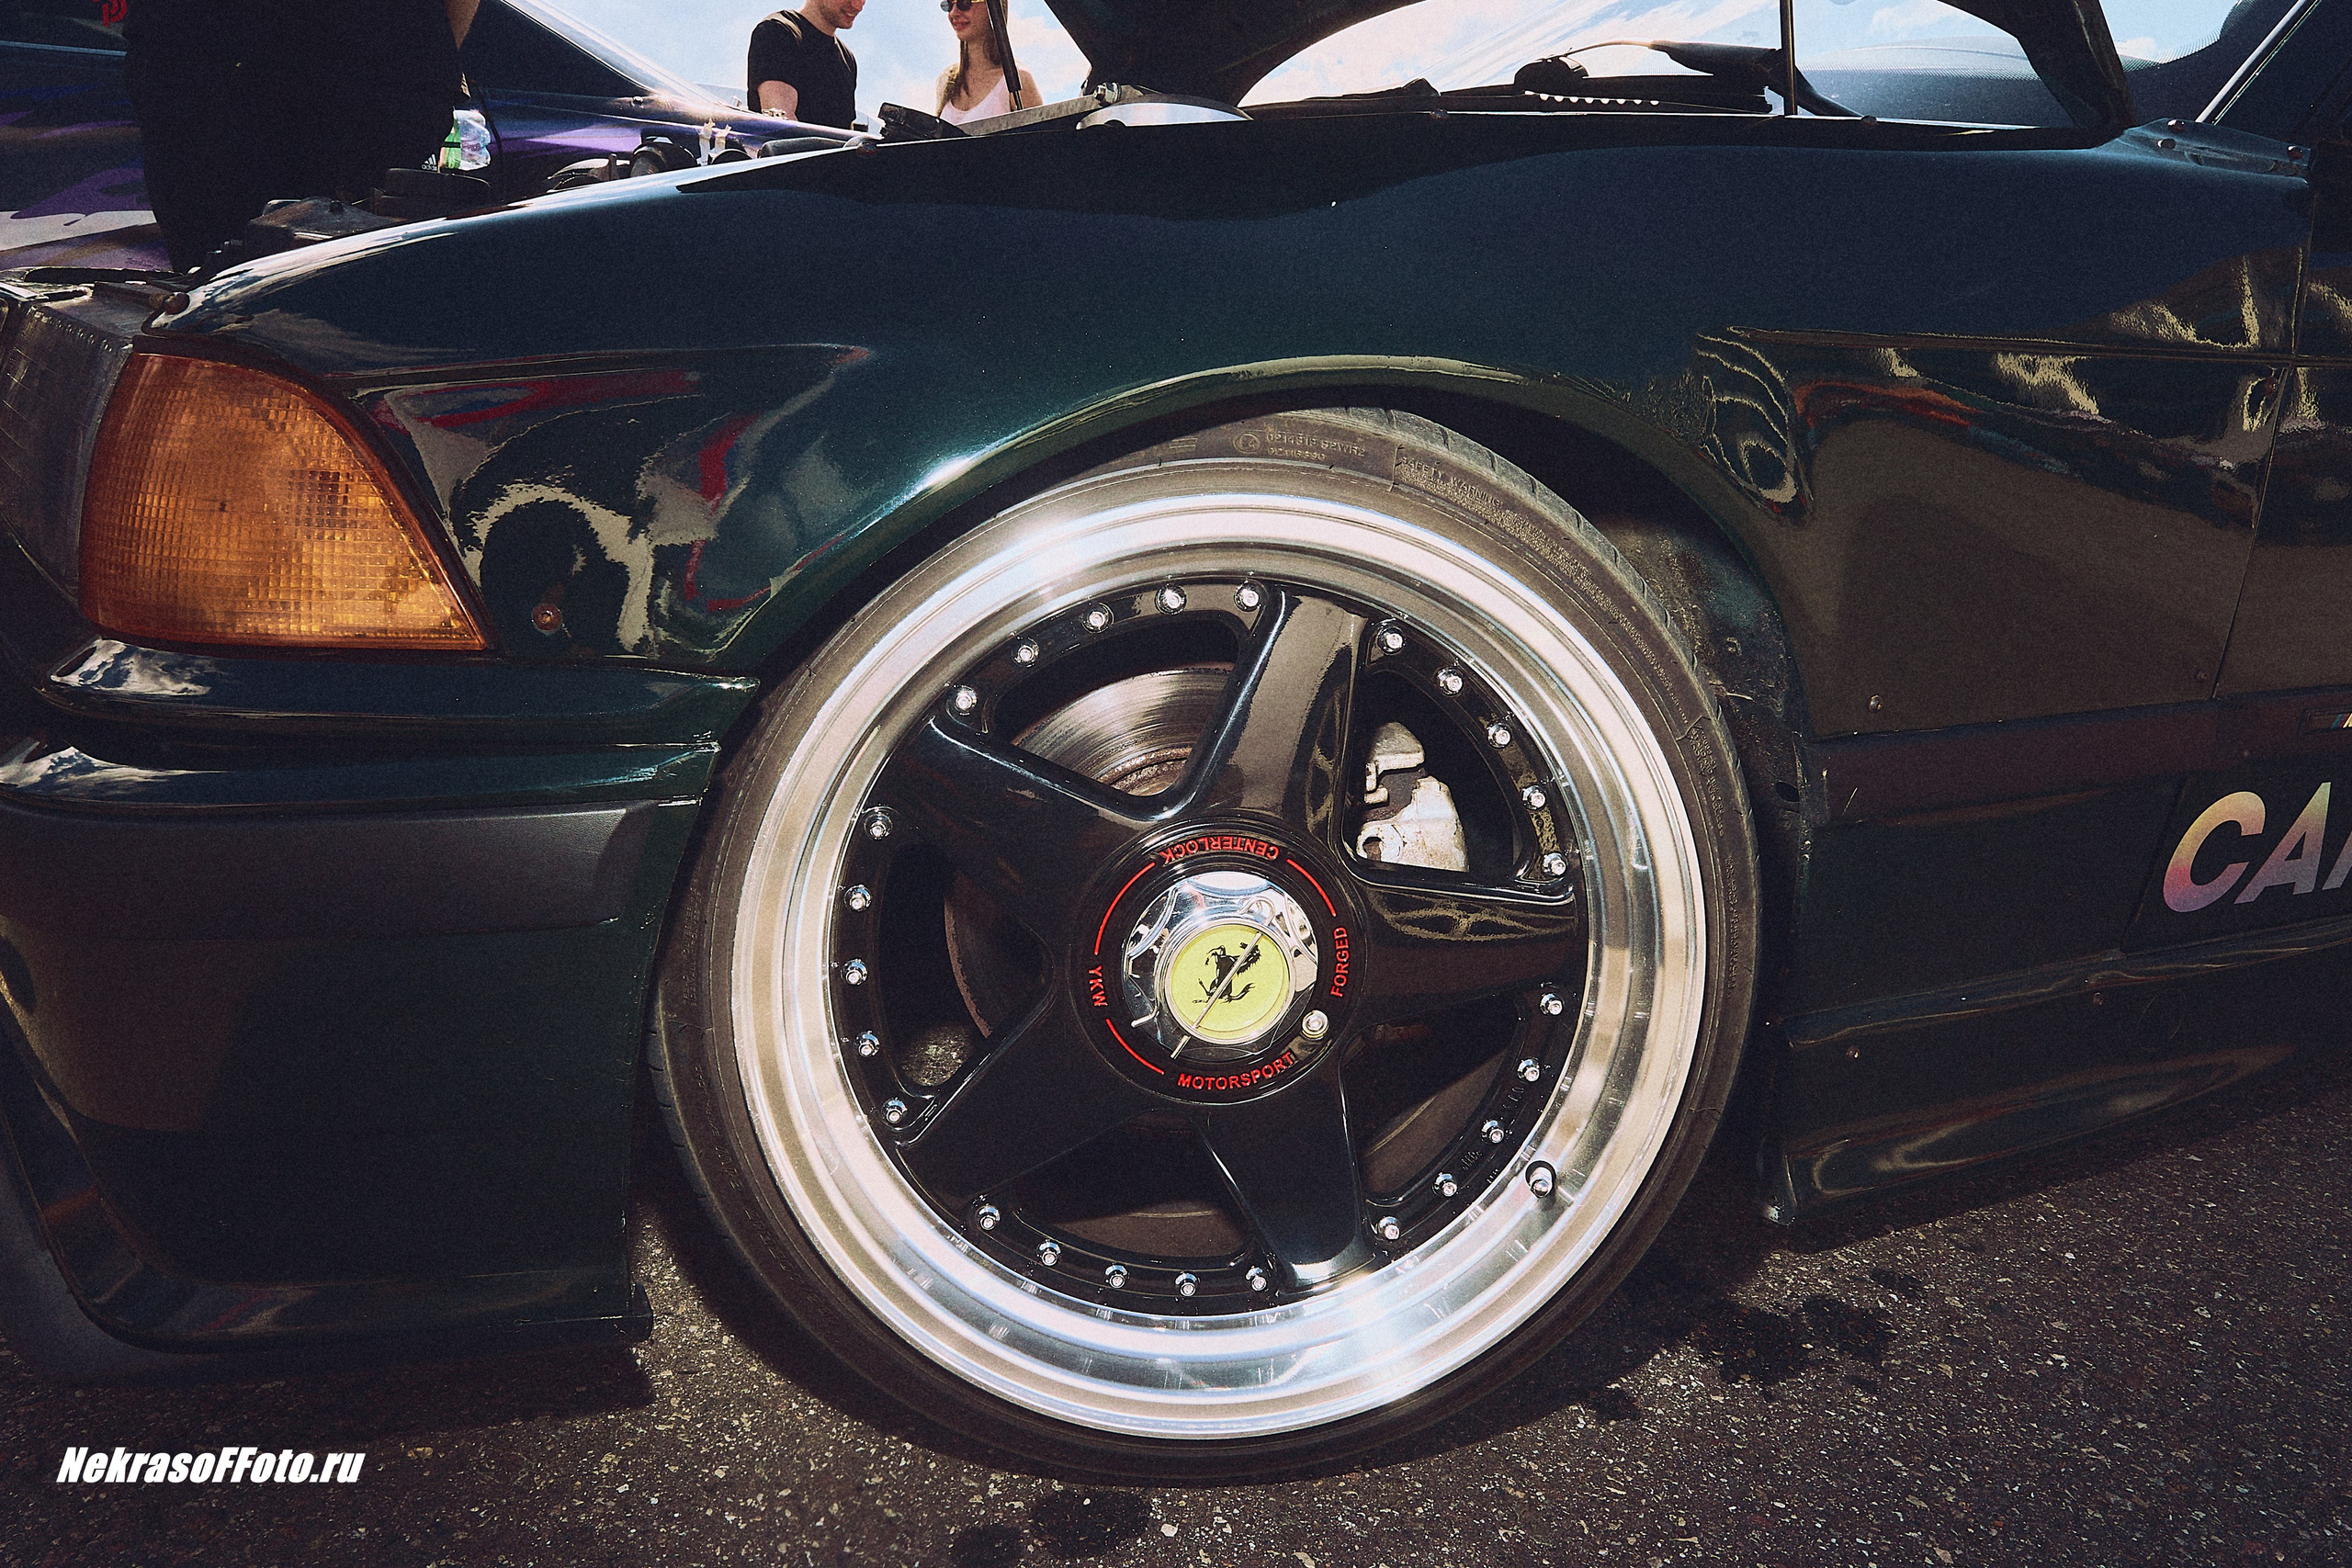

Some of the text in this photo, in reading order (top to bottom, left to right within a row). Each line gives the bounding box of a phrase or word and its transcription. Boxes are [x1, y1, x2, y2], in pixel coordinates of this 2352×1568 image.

[1401, 457, 1445, 479] SAFETY
[1159, 835, 1280, 864] CENTERLOCK
[2163, 782, 2352, 913] CA
[1329, 927, 1351, 998] FORGED
[1088, 964, 1108, 1007] YKW
[1177, 1051, 1295, 1090] MOTORSPORT
